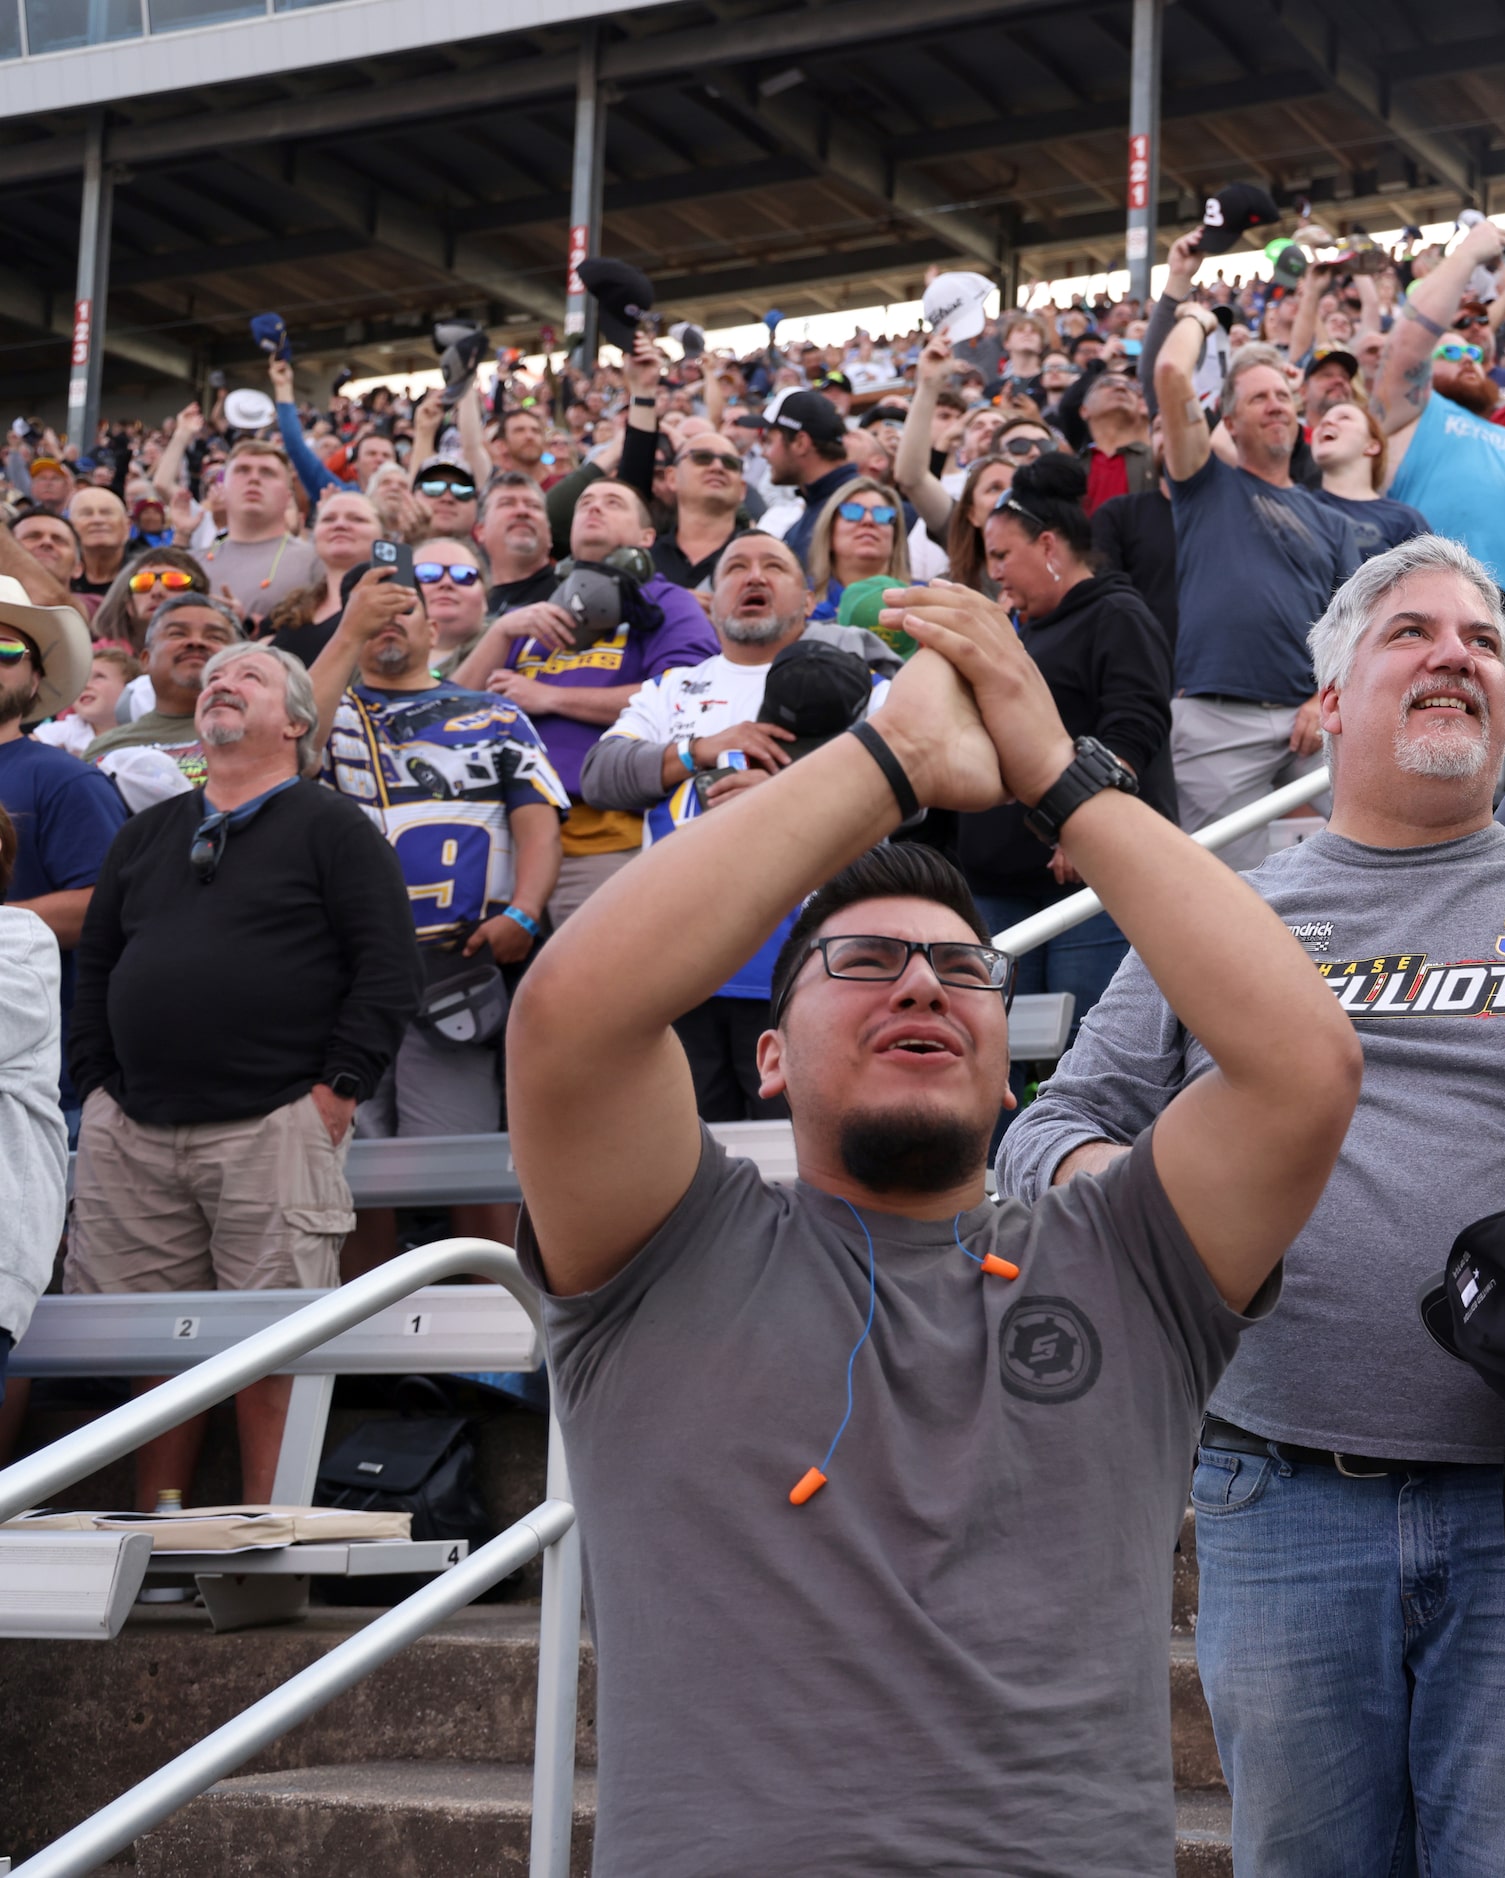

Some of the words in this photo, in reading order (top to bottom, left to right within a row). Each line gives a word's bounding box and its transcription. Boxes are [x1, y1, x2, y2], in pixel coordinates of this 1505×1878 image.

[1131, 137, 1148, 206] 121
[73, 301, 90, 362] 123
[391, 817, 494, 937] 9
[1287, 921, 1334, 937] ndrick
[1319, 956, 1411, 976] HASE
[179, 1319, 193, 1337] 2
[411, 1315, 422, 1334] 1
[447, 1545, 459, 1566] 4
